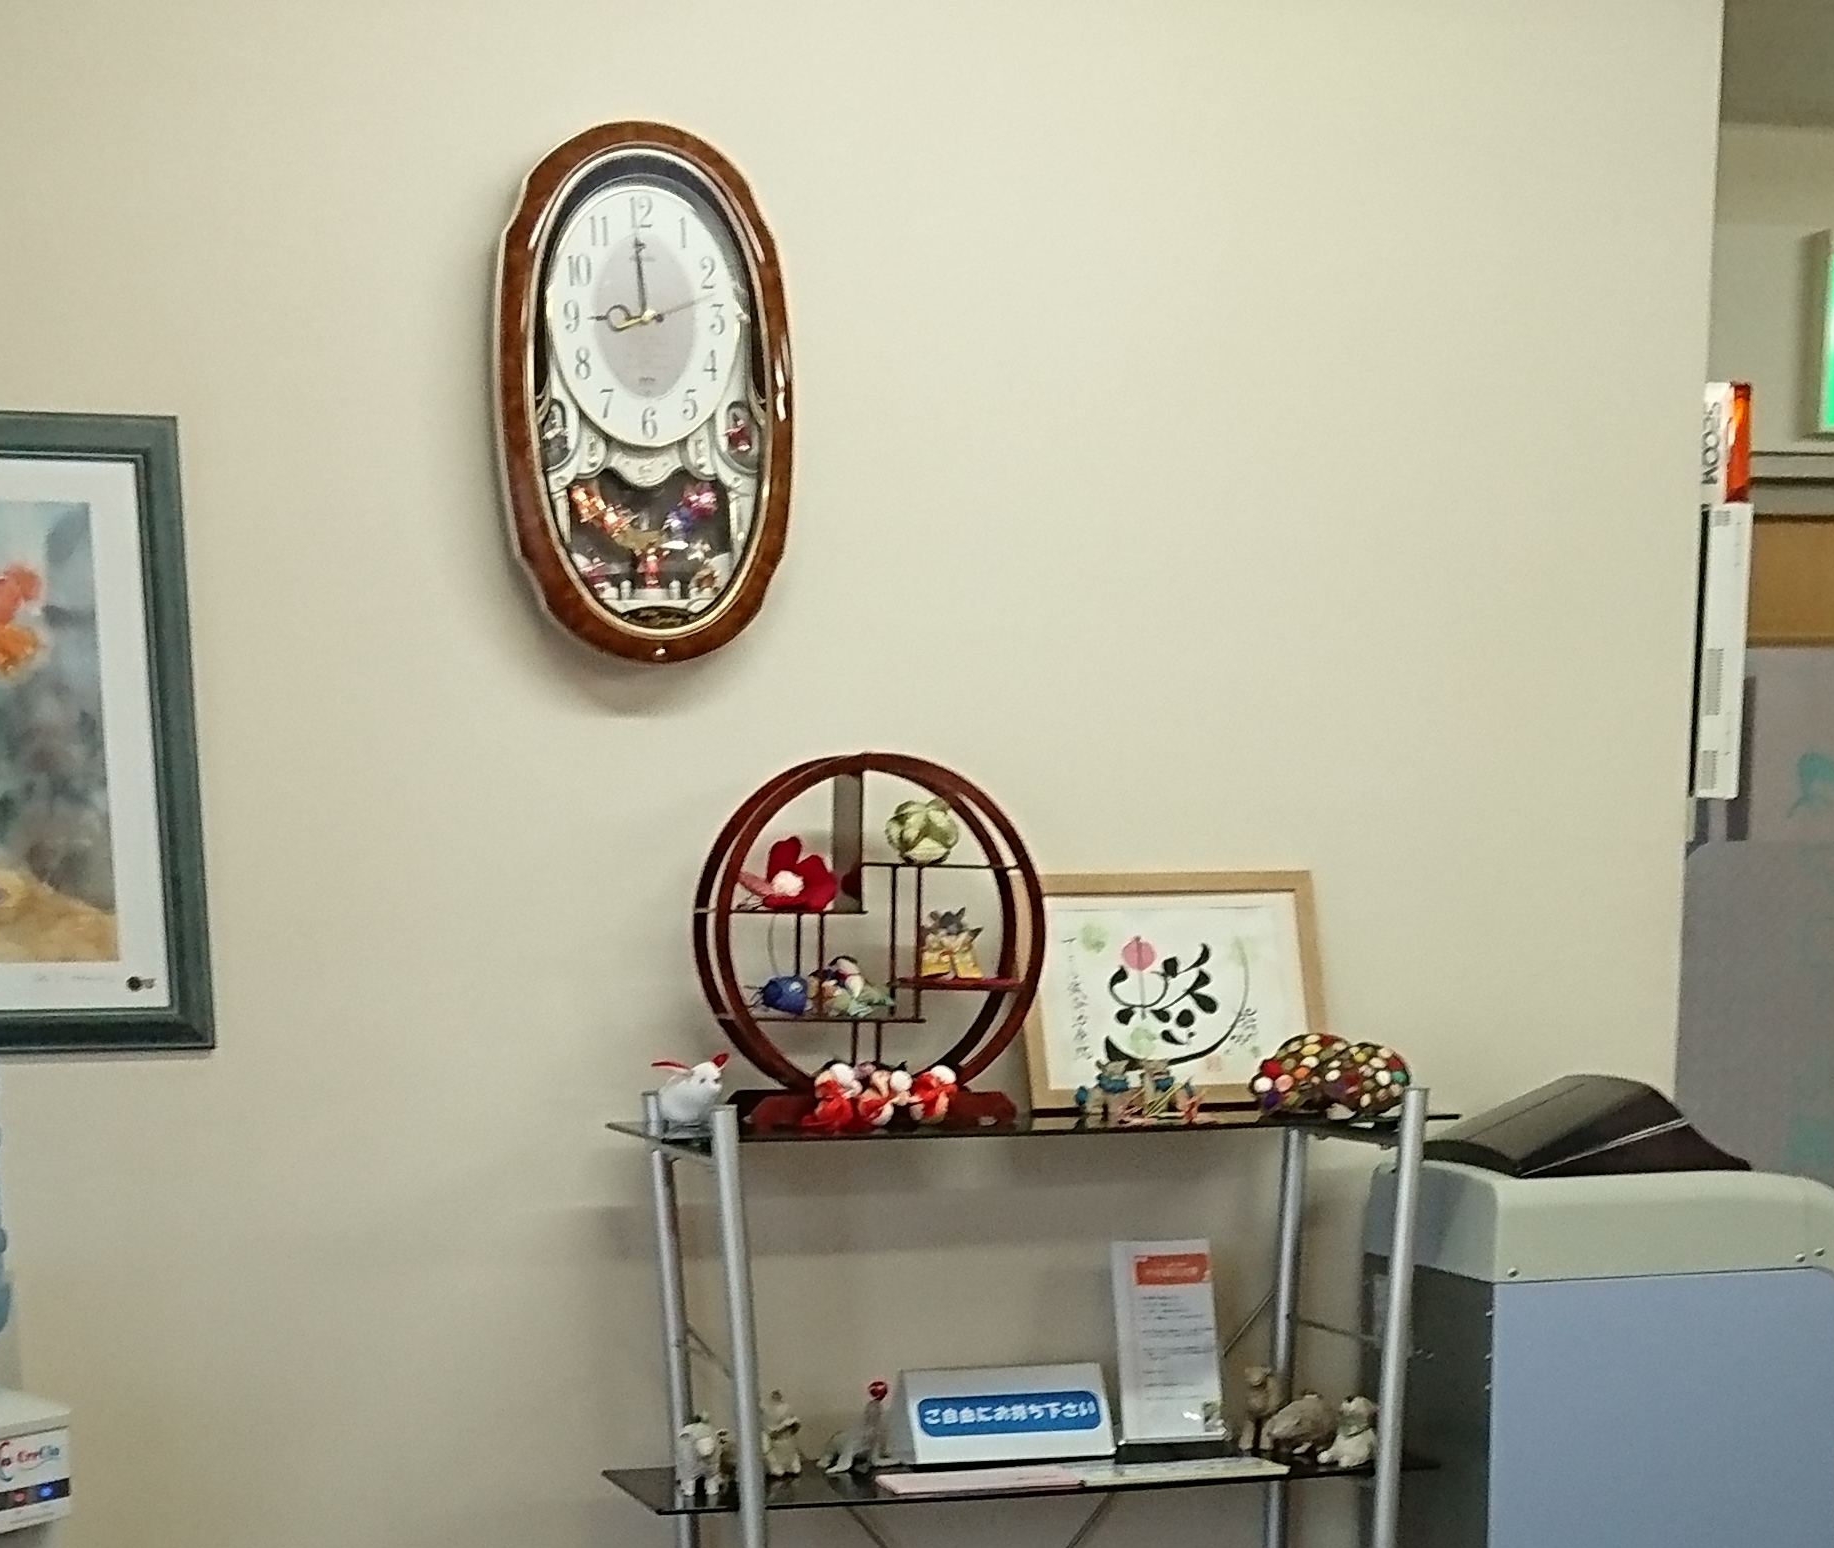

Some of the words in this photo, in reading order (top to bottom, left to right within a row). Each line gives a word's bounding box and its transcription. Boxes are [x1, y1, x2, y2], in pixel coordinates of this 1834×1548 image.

[629, 196, 653, 229] 12
[589, 215, 609, 247] 11
[678, 216, 687, 249] 1
[567, 254, 592, 287] 10
[699, 256, 717, 290] 2
[563, 300, 580, 333] 9
[710, 303, 725, 336] 3
[574, 347, 591, 380] 8
[703, 349, 718, 382] 4
[599, 388, 614, 419] 7
[682, 389, 698, 421] 5
[641, 406, 658, 440] 6
[1700, 401, 1720, 485] SECOM
[923, 1400, 1097, 1426] ご自由にお持ち下さい
